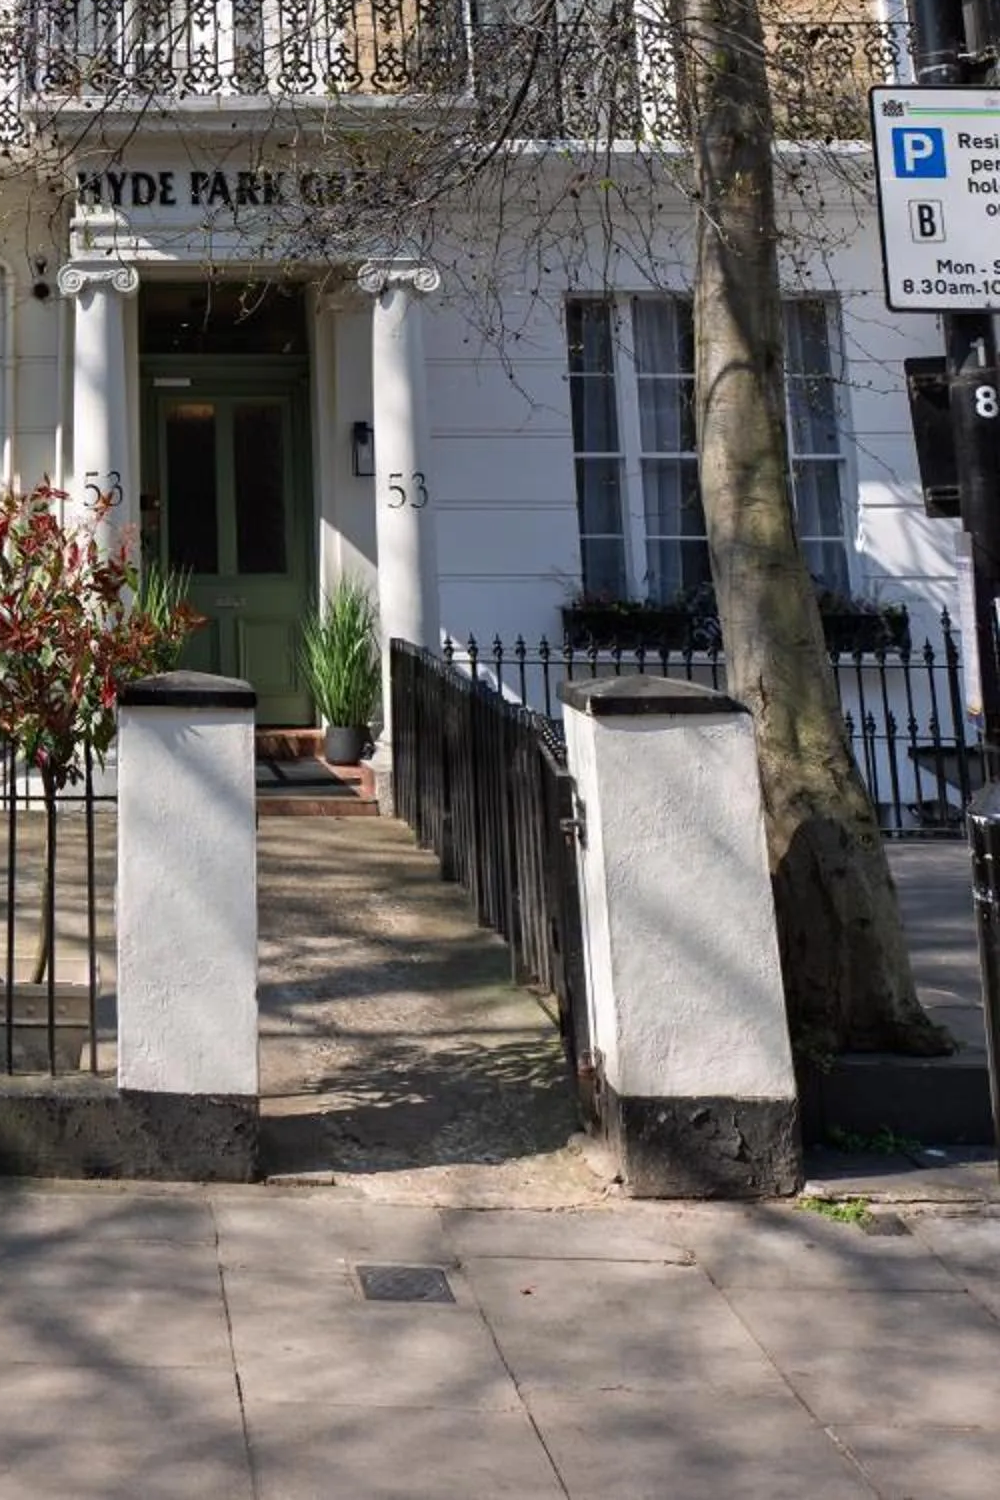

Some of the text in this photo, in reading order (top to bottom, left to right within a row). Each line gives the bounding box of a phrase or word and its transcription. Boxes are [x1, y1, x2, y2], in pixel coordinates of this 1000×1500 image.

[903, 132, 933, 172] P
[77, 171, 177, 206] HYDE
[190, 171, 287, 206] PARK
[917, 203, 937, 237] B
[936, 259, 975, 274] Mon
[975, 385, 999, 418] 8
[83, 471, 123, 508] 53
[387, 471, 429, 508] 53
